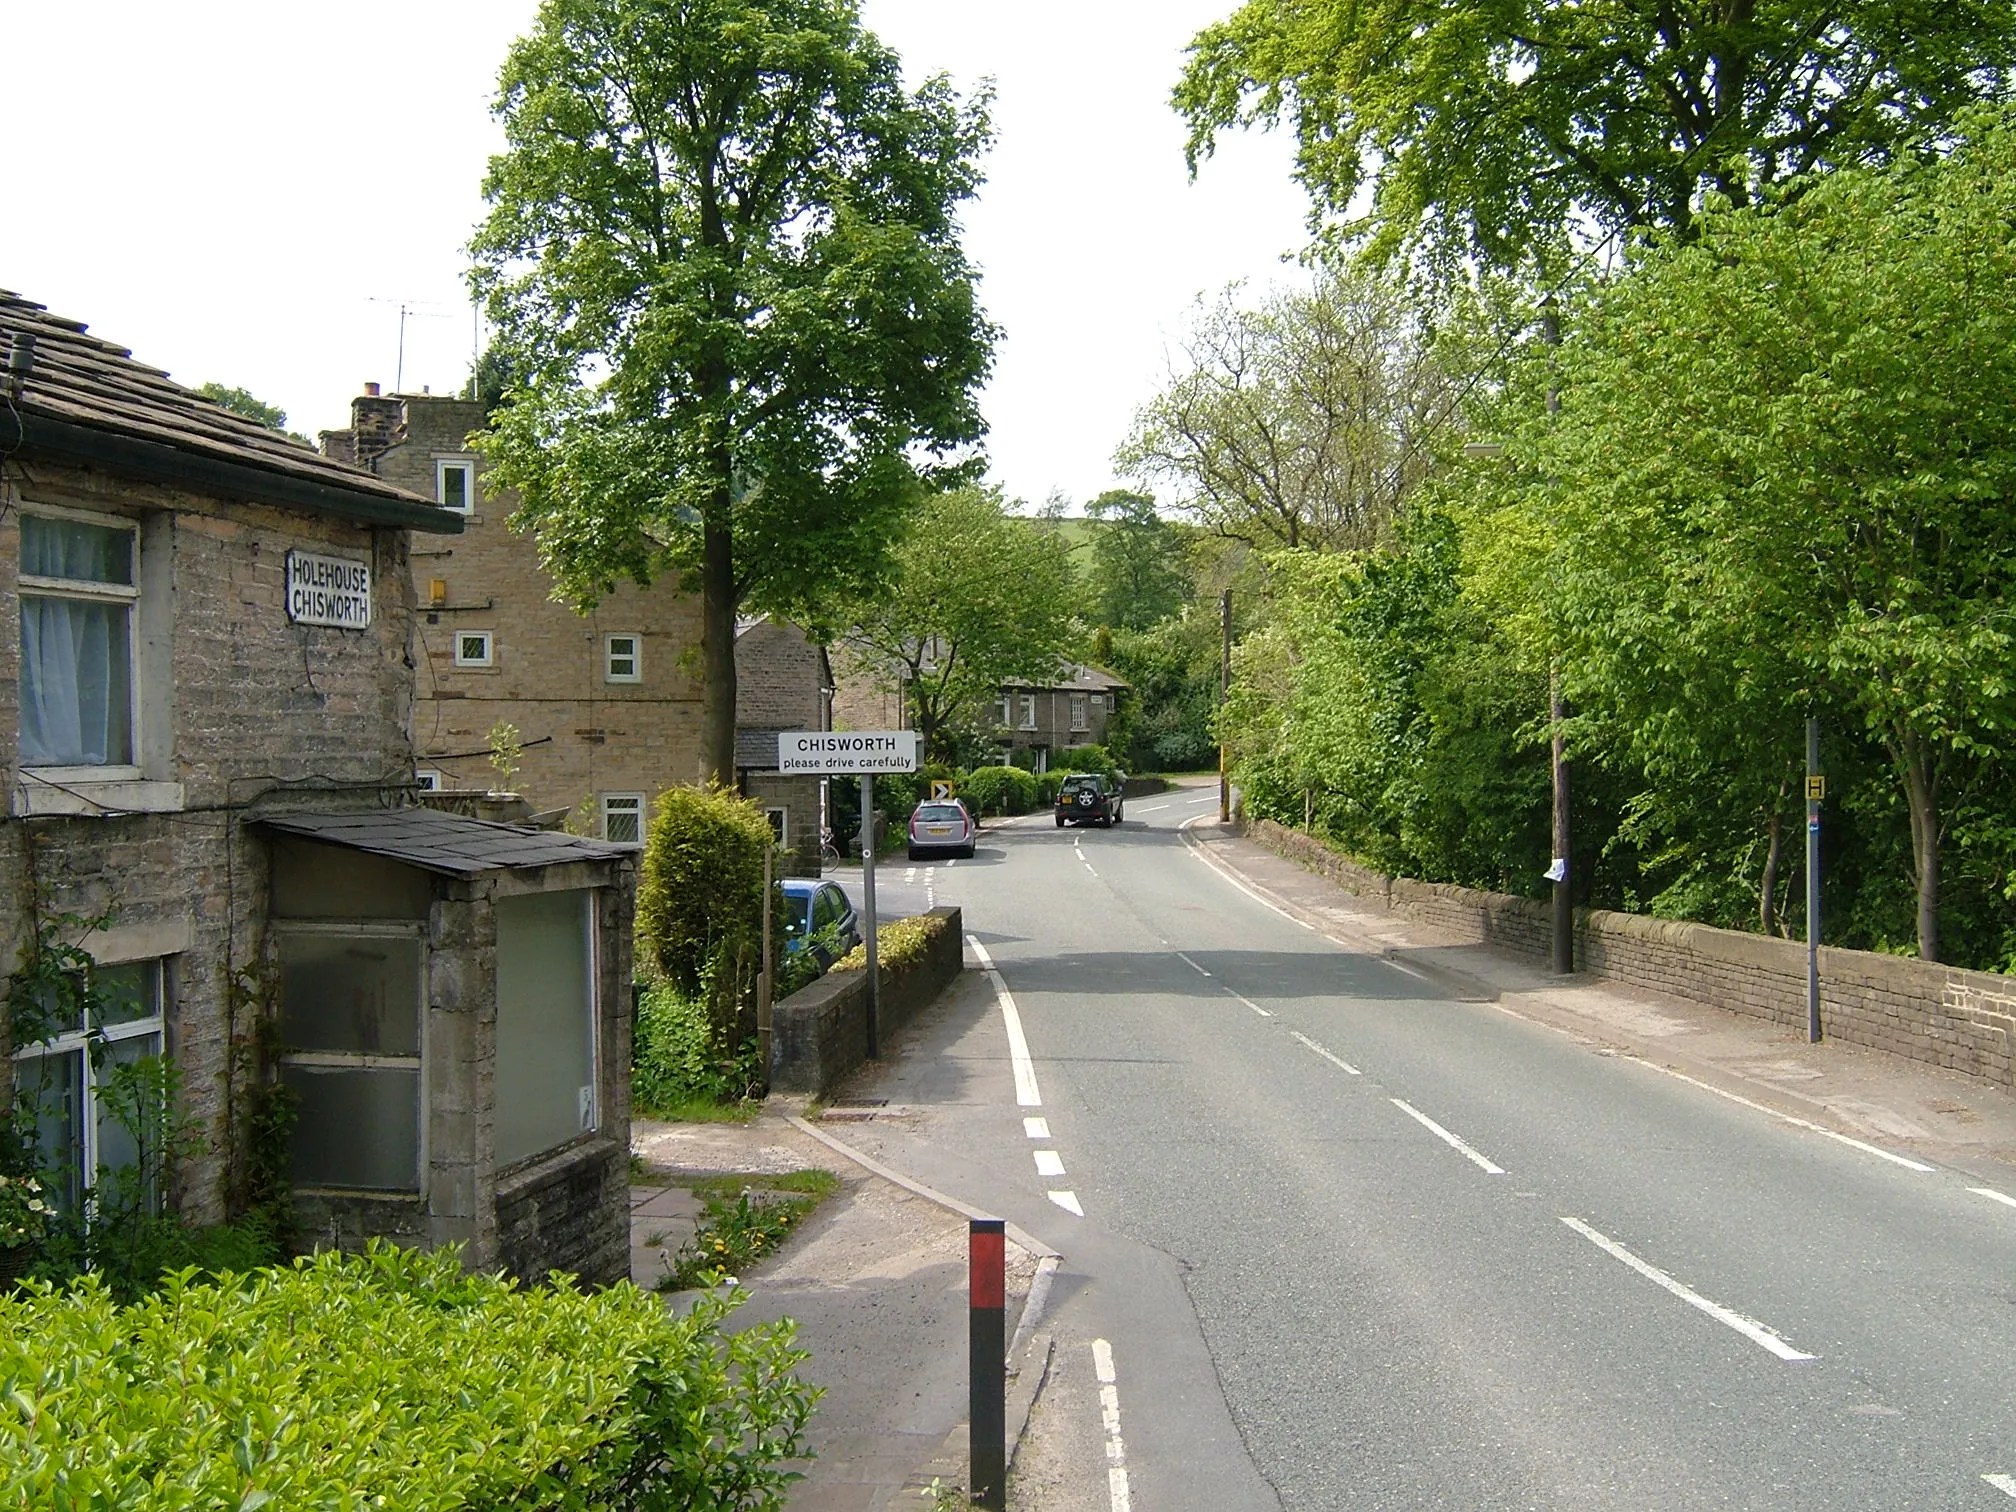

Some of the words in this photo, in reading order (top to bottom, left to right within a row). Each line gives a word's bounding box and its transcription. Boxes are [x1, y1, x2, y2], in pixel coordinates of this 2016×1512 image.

[292, 555, 367, 593] HOLEHOUSE
[293, 589, 368, 624] CHISWORTH
[797, 738, 896, 751] CHISWORTH
[783, 758, 821, 769] please
[825, 757, 854, 768] drive
[859, 756, 912, 769] carefully
[1808, 779, 1821, 796] H
